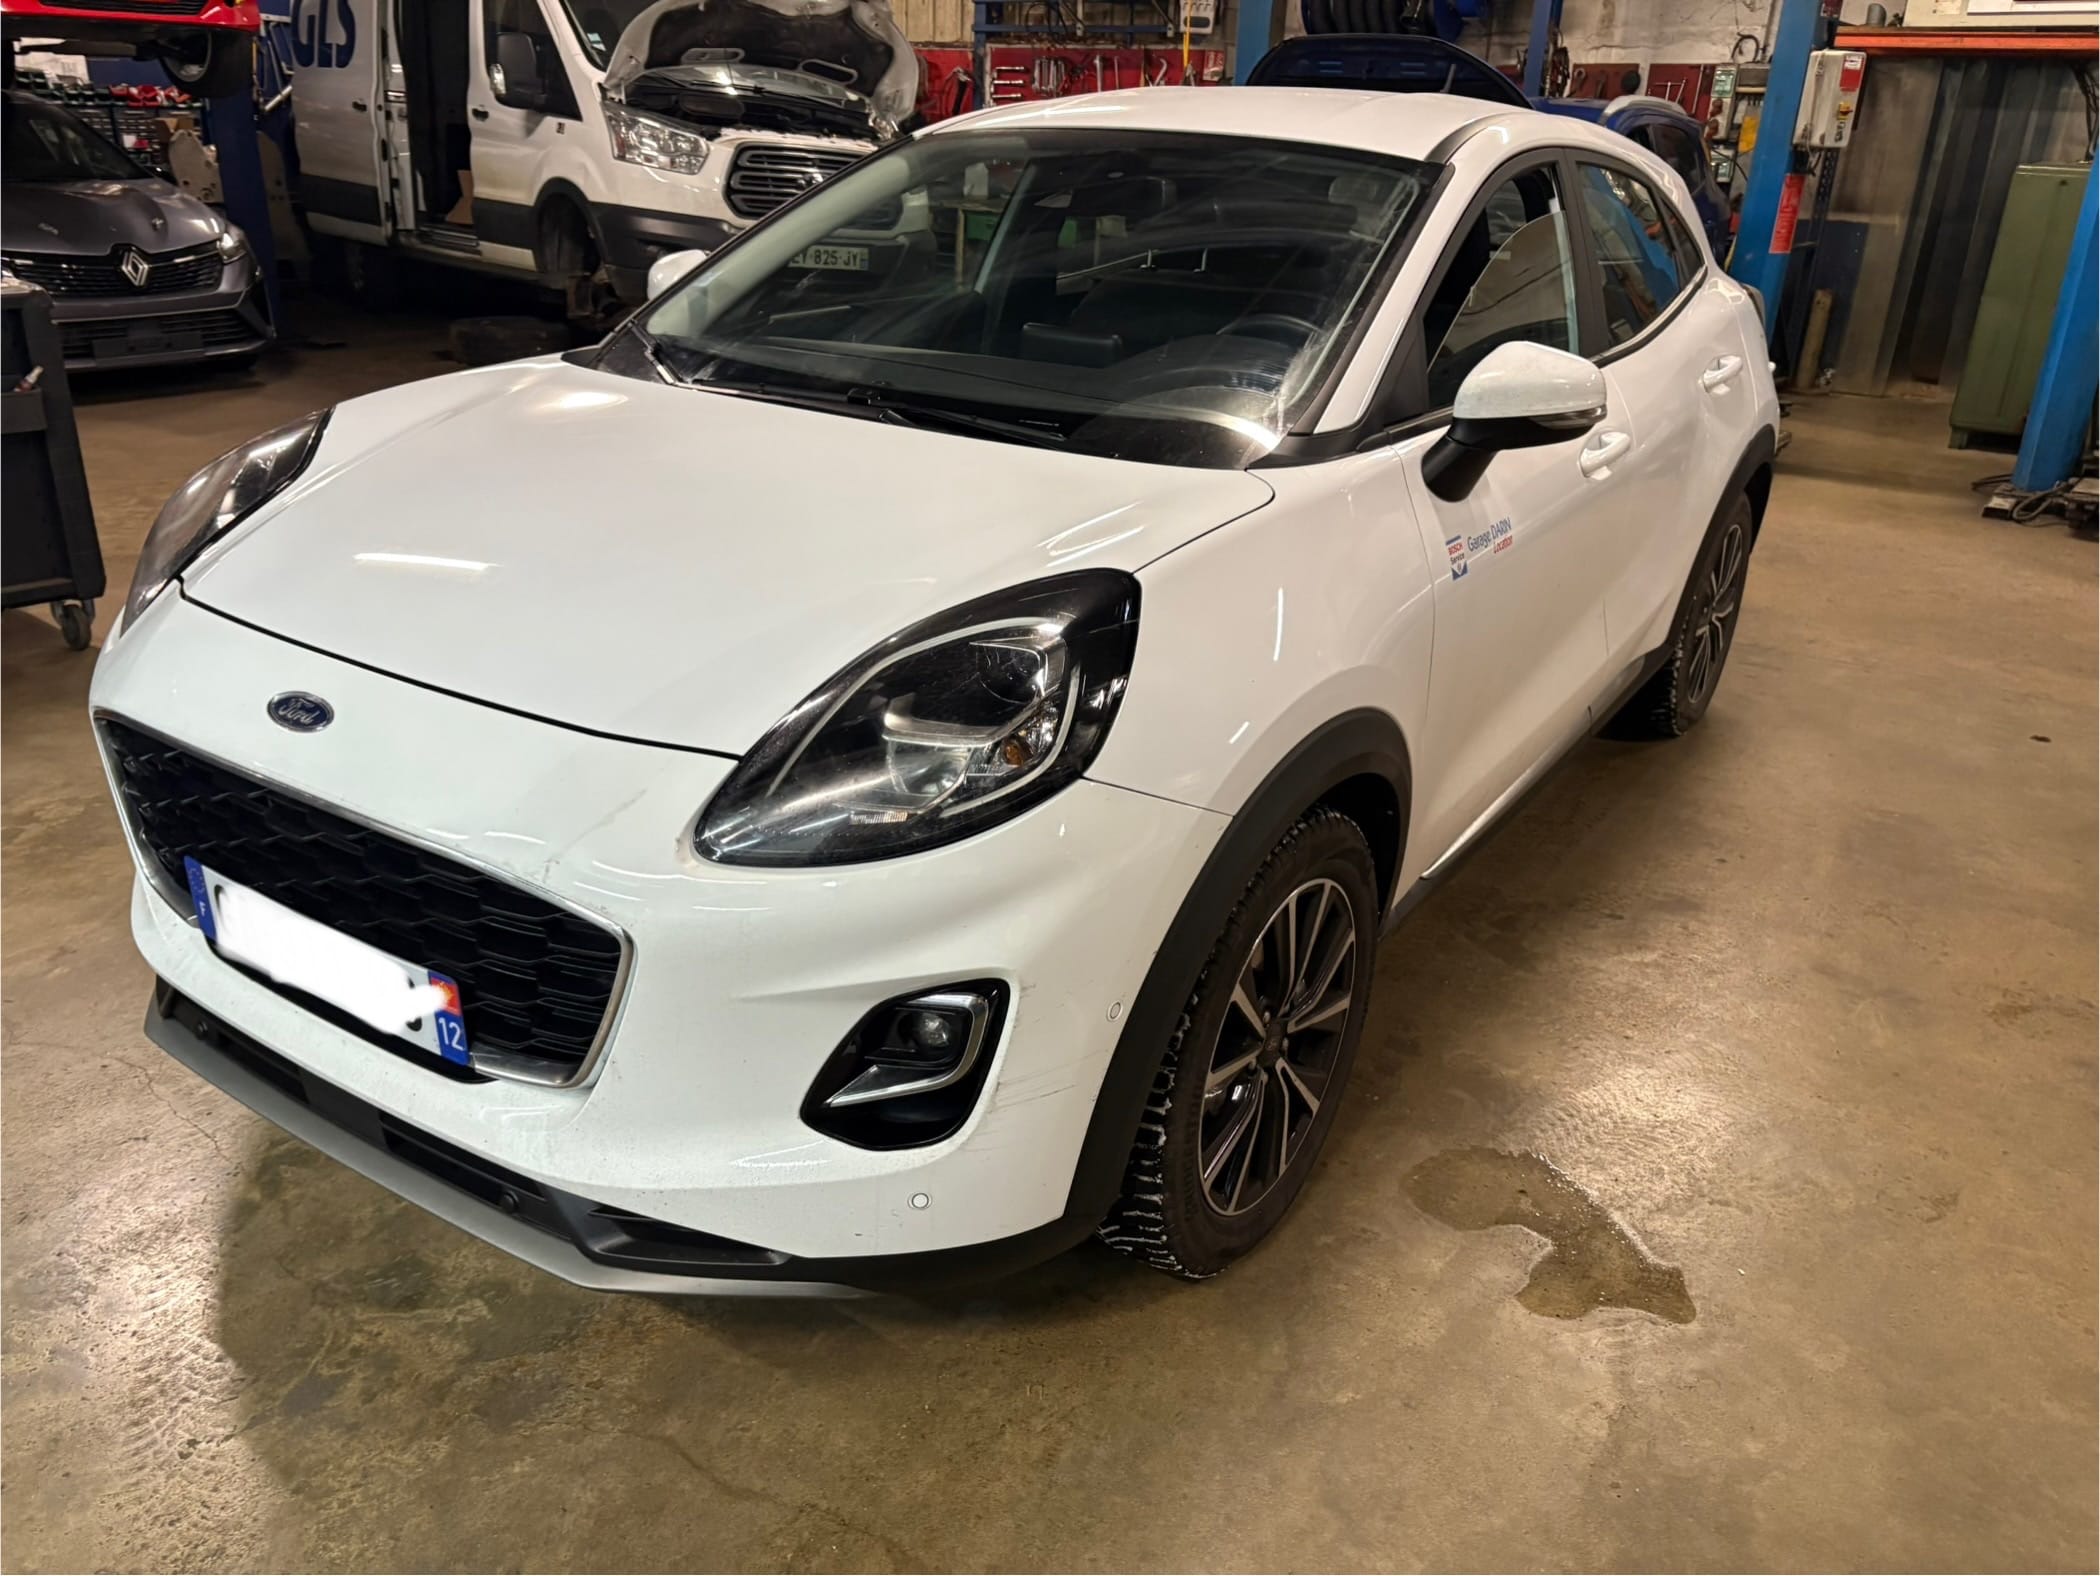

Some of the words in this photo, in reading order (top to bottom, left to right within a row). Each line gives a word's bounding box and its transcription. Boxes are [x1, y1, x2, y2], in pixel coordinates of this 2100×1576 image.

[1467, 530, 1491, 552] Garage
[278, 698, 320, 725] Ford
[438, 1017, 465, 1051] 12
